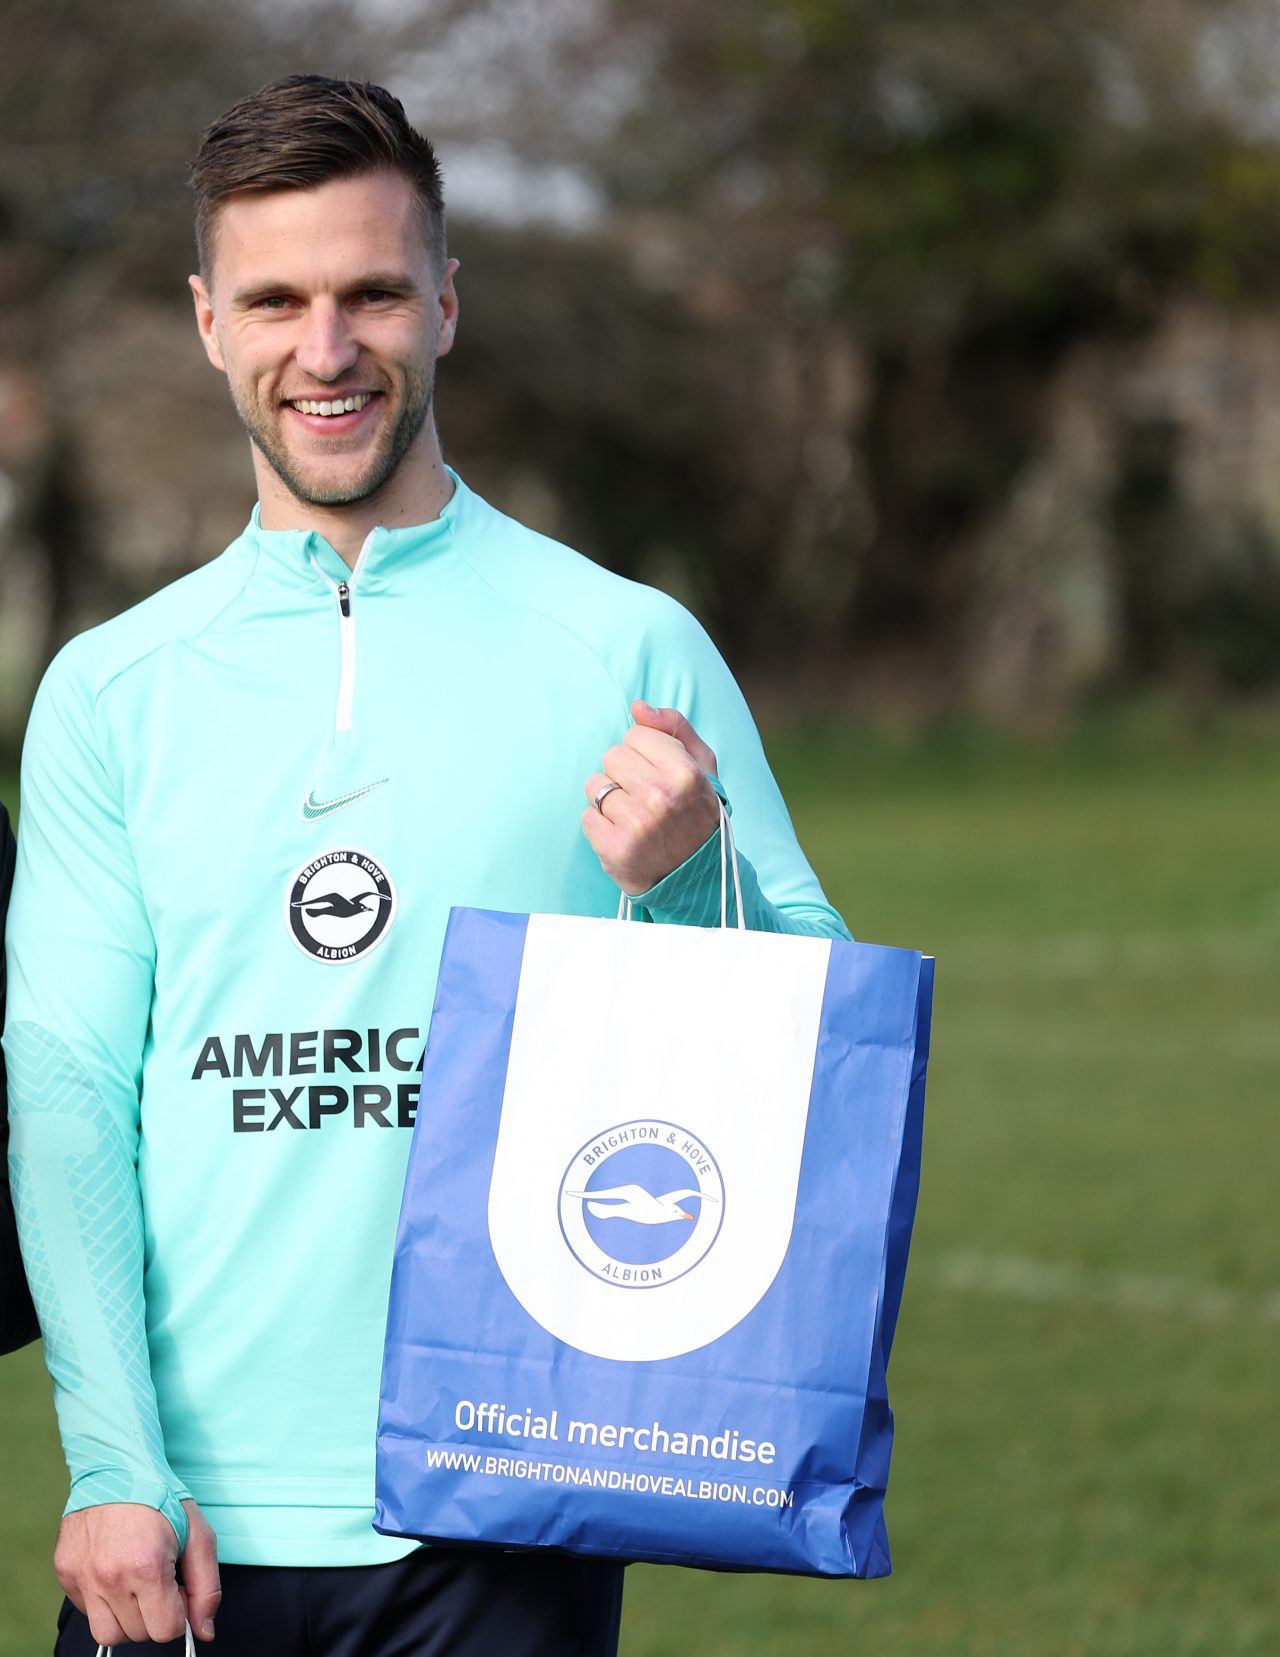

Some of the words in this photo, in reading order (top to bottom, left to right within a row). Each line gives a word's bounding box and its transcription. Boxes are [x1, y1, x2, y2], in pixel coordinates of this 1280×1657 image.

[299, 853, 347, 885] BRIGHTON
[351, 854, 359, 864] &
[361, 859, 385, 883] HOVE
[317, 946, 357, 958] ALBION
[232, 1084, 420, 1132] EXPRE
[583, 1127, 659, 1166] BRIGHTON
[666, 1132, 677, 1145] &
[682, 1140, 712, 1175] HOVE
[601, 1263, 662, 1281] ALBION
[455, 1401, 558, 1441] Official
[567, 1421, 776, 1464] merchandise
[426, 1449, 794, 1507] WWW.BRIGHTONANDHOVEALBION.COM
